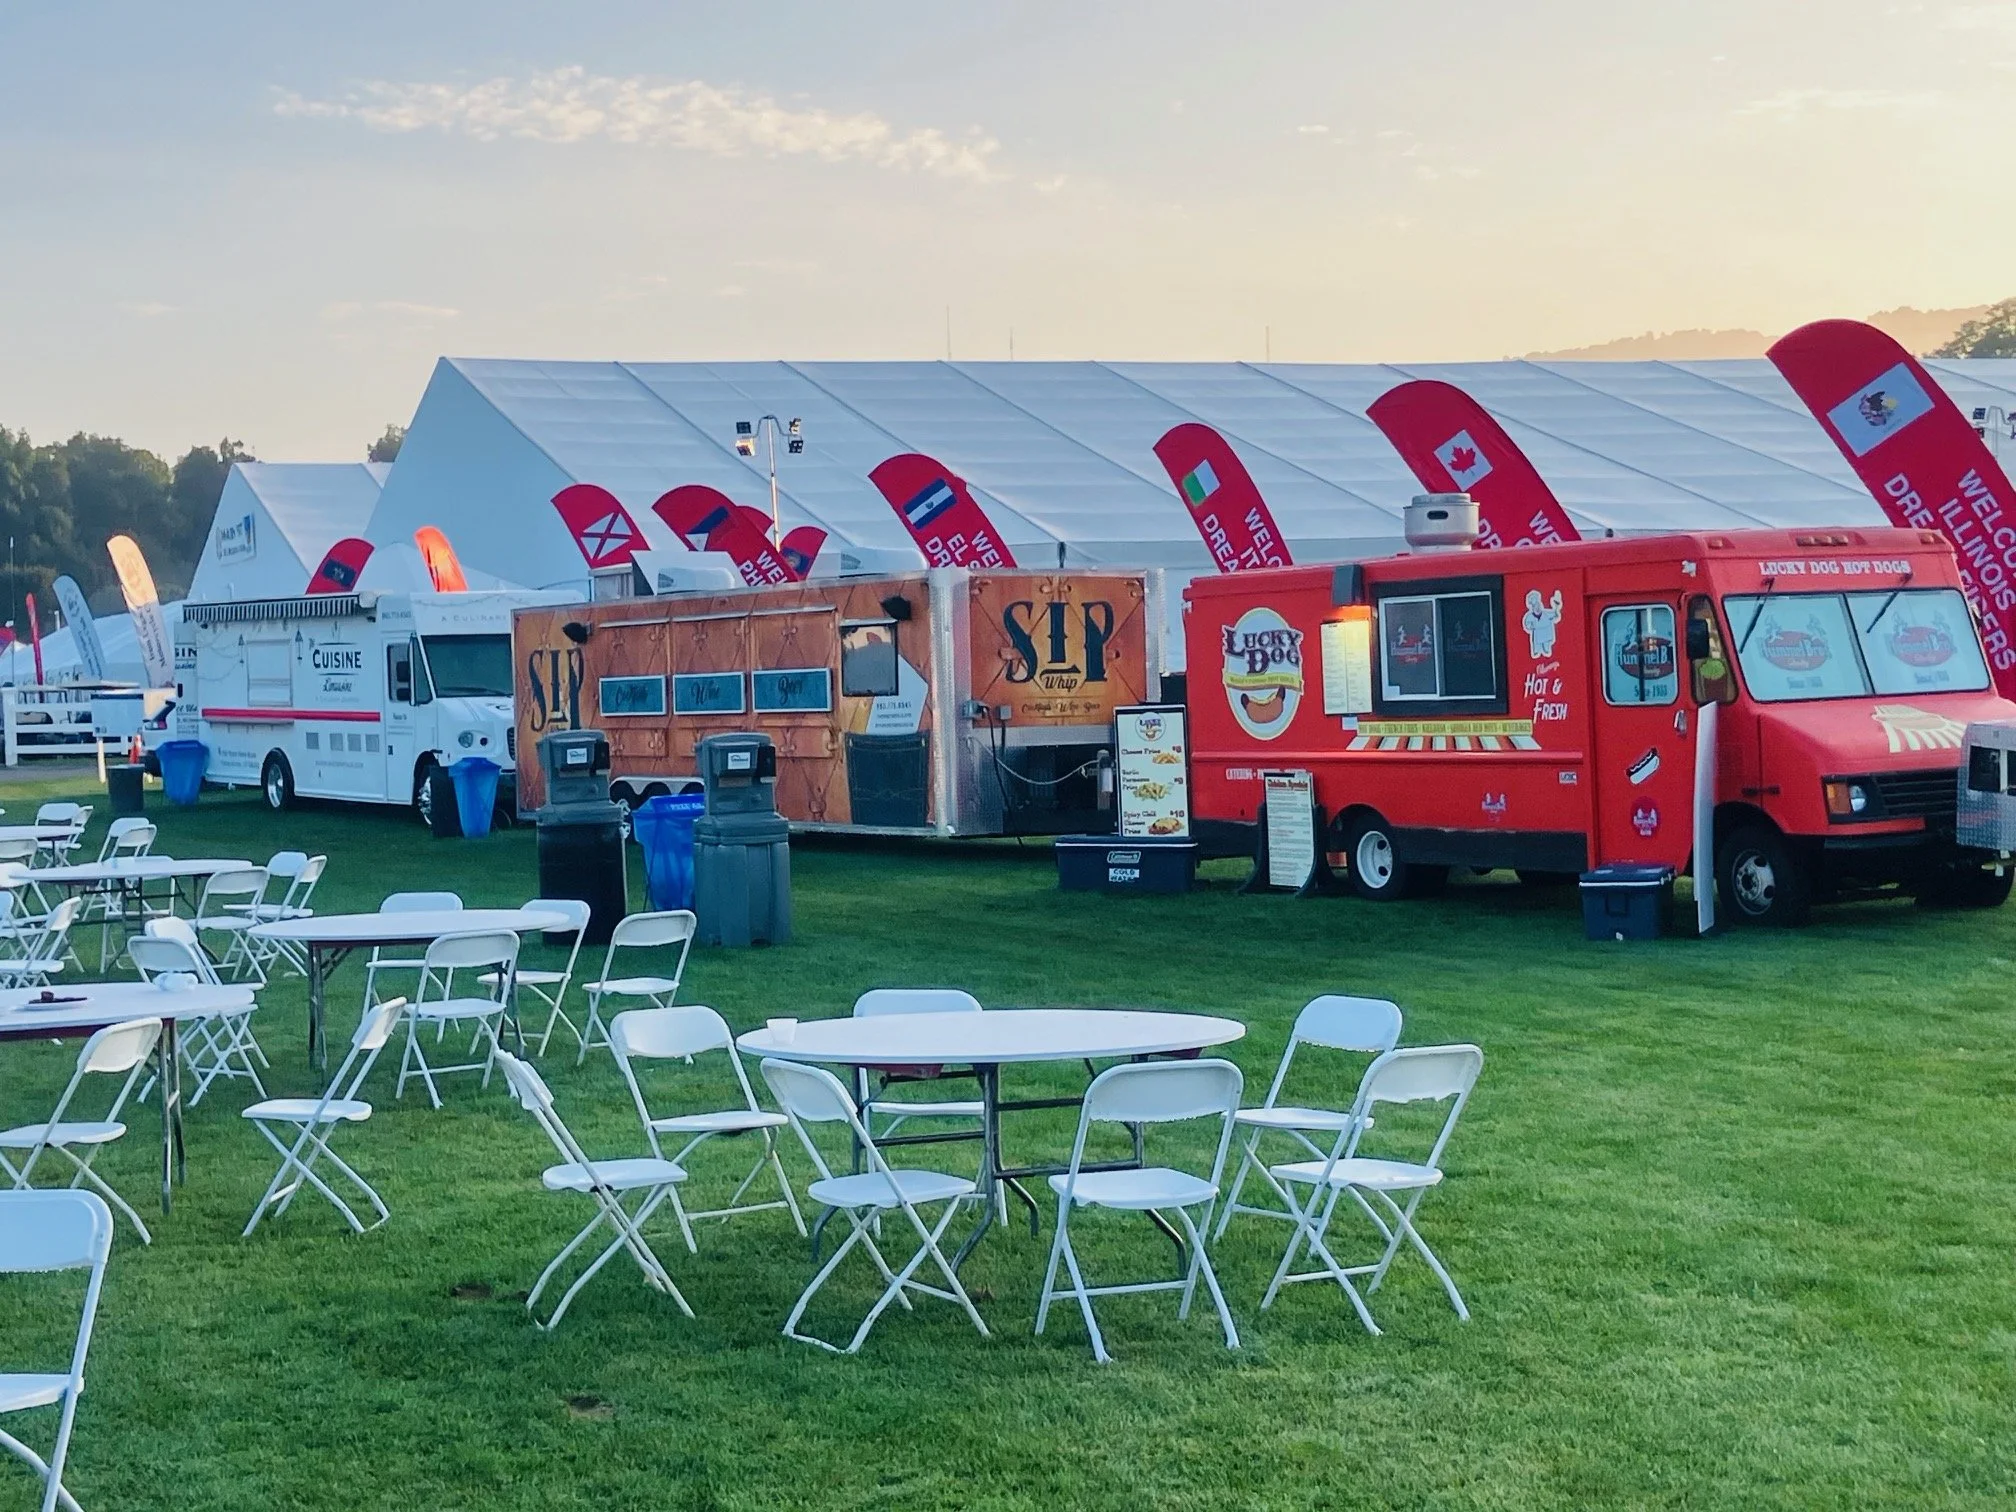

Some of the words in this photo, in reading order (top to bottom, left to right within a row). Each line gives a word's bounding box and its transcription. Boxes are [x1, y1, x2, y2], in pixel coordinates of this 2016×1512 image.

[1884, 472, 1934, 529] DRE
[1202, 513, 1239, 572] DREA
[1244, 506, 1283, 569] WELC
[1957, 468, 2016, 578] WELCO
[1758, 561, 1806, 576] LUCKY
[1809, 560, 1840, 575] DOG
[1841, 561, 1871, 575] HOT
[1872, 560, 1912, 575] DOGS
[1938, 498, 2016, 611] ILLINOIS
[312, 648, 362, 669] CUISINE
[1003, 599, 1114, 684] SIP
[1225, 628, 1301, 658] LUCKY
[1246, 647, 1300, 676] DOG
[528, 648, 584, 732] SIP
[1044, 675, 1079, 693] Whip
[1524, 673, 1549, 699] HOT
[1552, 678, 1563, 695] &
[1533, 698, 1568, 725] FRESH
